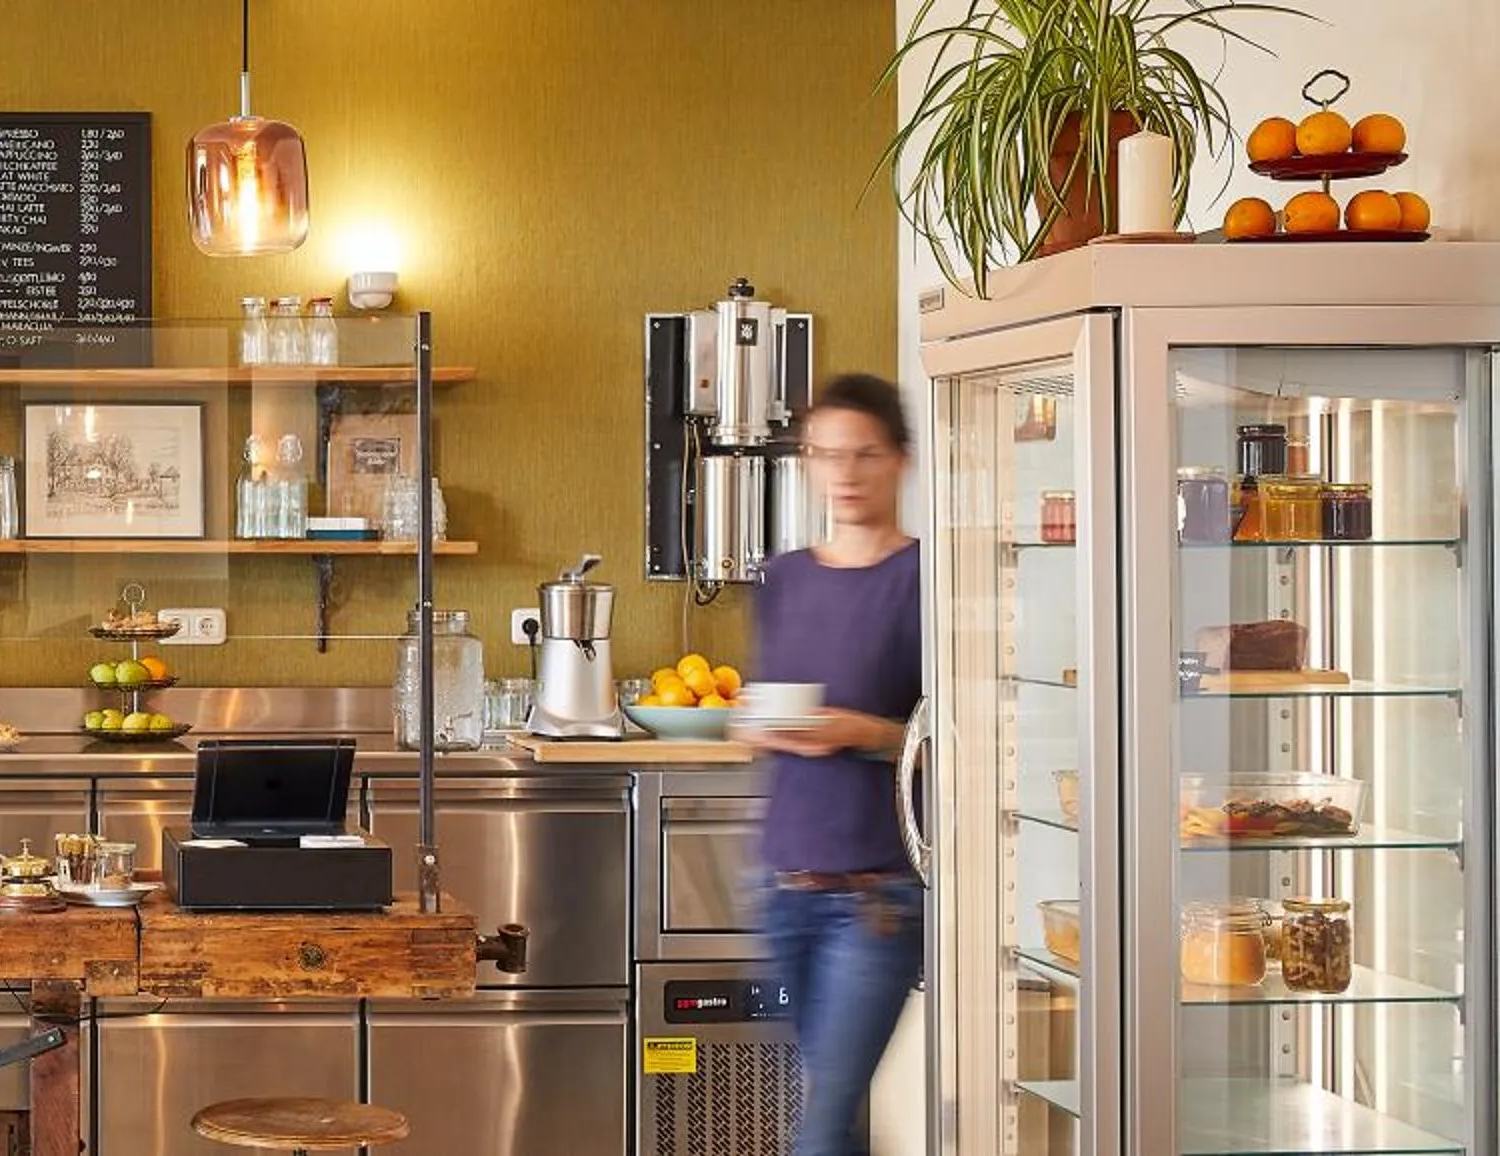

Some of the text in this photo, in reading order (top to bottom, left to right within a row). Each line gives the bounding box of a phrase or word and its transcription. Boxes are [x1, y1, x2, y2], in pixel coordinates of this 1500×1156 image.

[17, 172, 49, 181] WHITE
[17, 203, 45, 213] LATTE
[21, 215, 47, 224] CHAI
